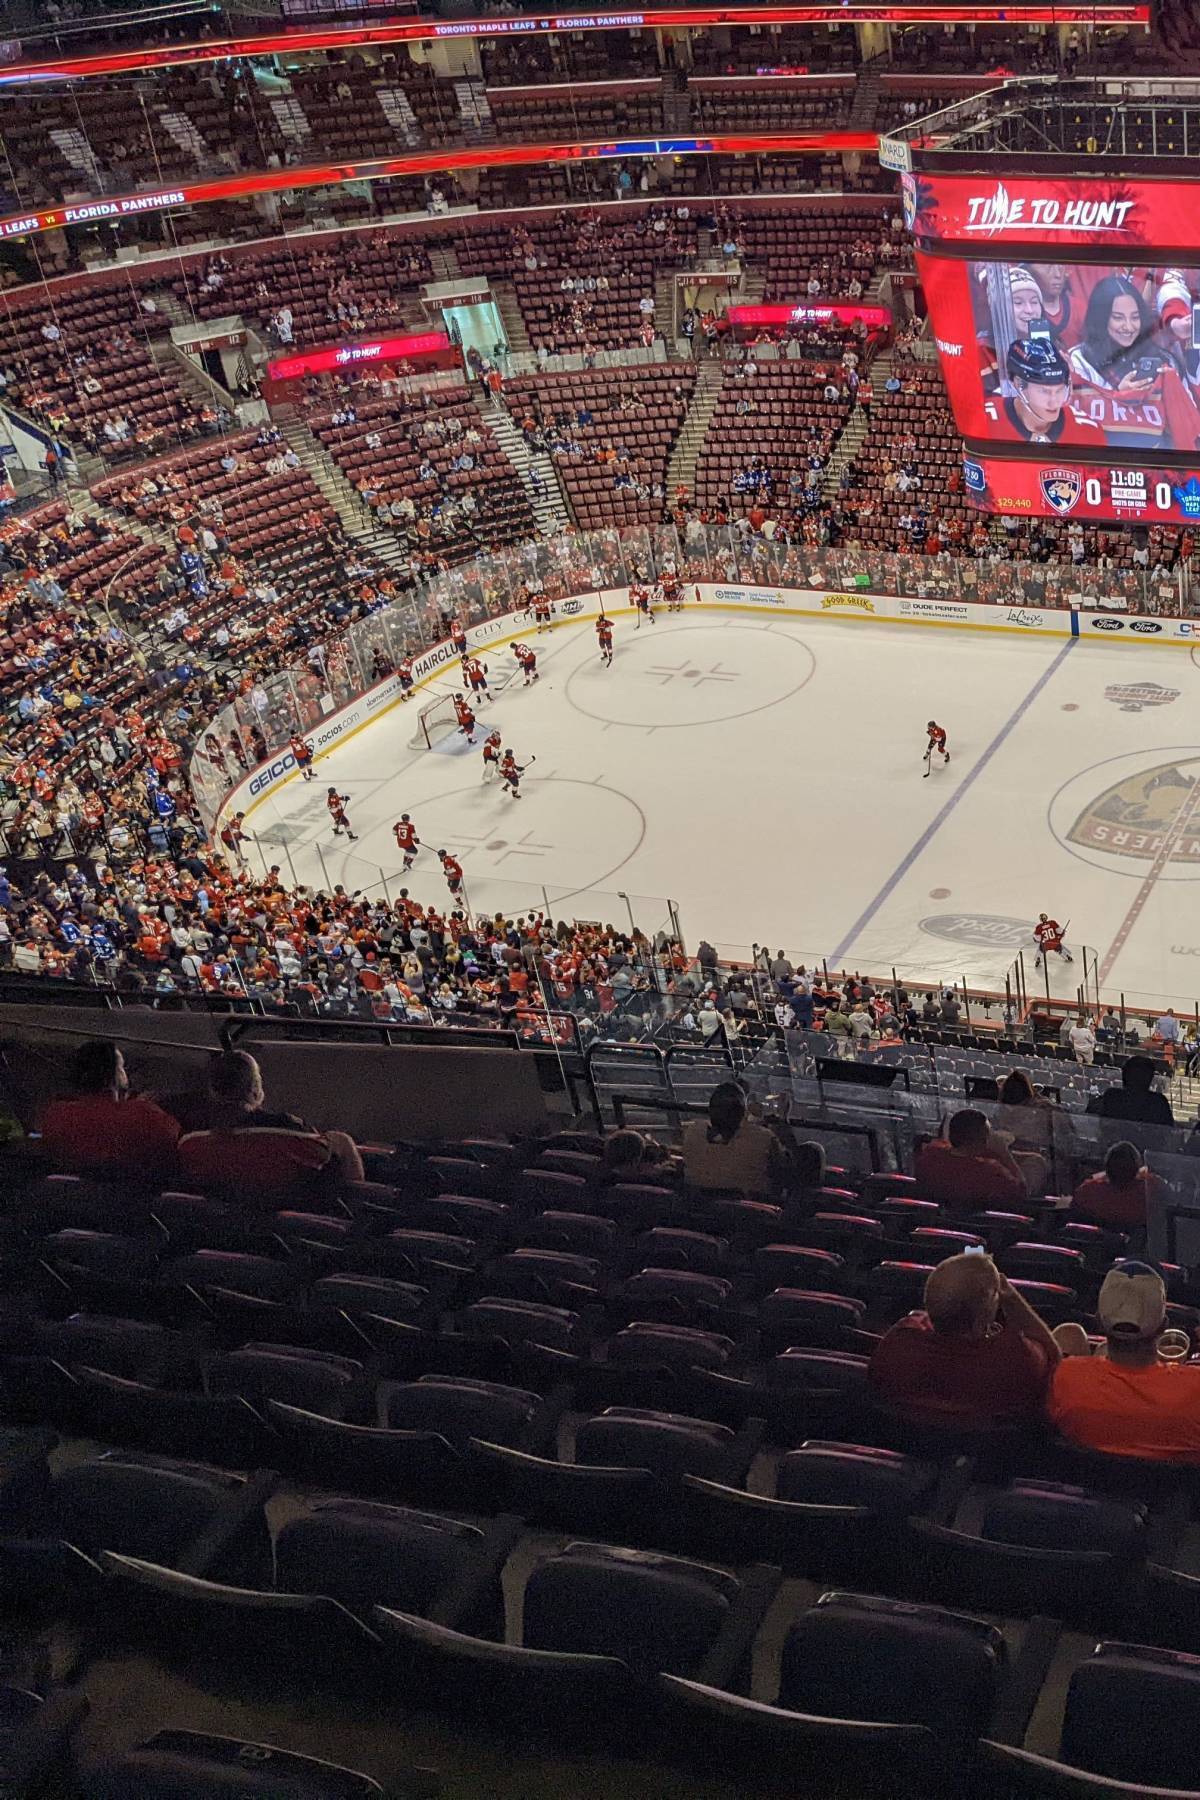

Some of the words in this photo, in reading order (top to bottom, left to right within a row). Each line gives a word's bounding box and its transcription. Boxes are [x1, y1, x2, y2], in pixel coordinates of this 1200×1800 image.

[435, 24, 477, 35] TORONTO
[479, 23, 508, 32] MAPLE
[510, 22, 536, 30] LEAFS
[556, 18, 595, 28] FLORIDA
[597, 15, 644, 25] PANTHERS
[6, 218, 39, 234] LEAFS
[45, 215, 56, 224] VS
[64, 200, 119, 222] FLORIDA
[121, 192, 185, 211] PANTHERS
[968, 186, 1025, 233] TIME
[1031, 200, 1059, 225] TO
[1063, 200, 1135, 226] HUNT
[1110, 470, 1144, 486] 11:09
[1086, 479, 1101, 505] 0
[1114, 489, 1142, 498] PRE-GAME
[1156, 483, 1171, 510] 0
[998, 496, 1032, 508] $29,440
[913, 603, 934, 611] DUDE
[935, 605, 967, 613] PERFECT
[474, 621, 503, 638] CITY
[1097, 618, 1119, 630] Ford
[1135, 621, 1157, 632] Ford
[415, 642, 459, 678] HAIRCLU
[317, 712, 360, 746] SOCIOS.com
[249, 753, 295, 796] GEICO
[1041, 928, 1055, 940] 30
